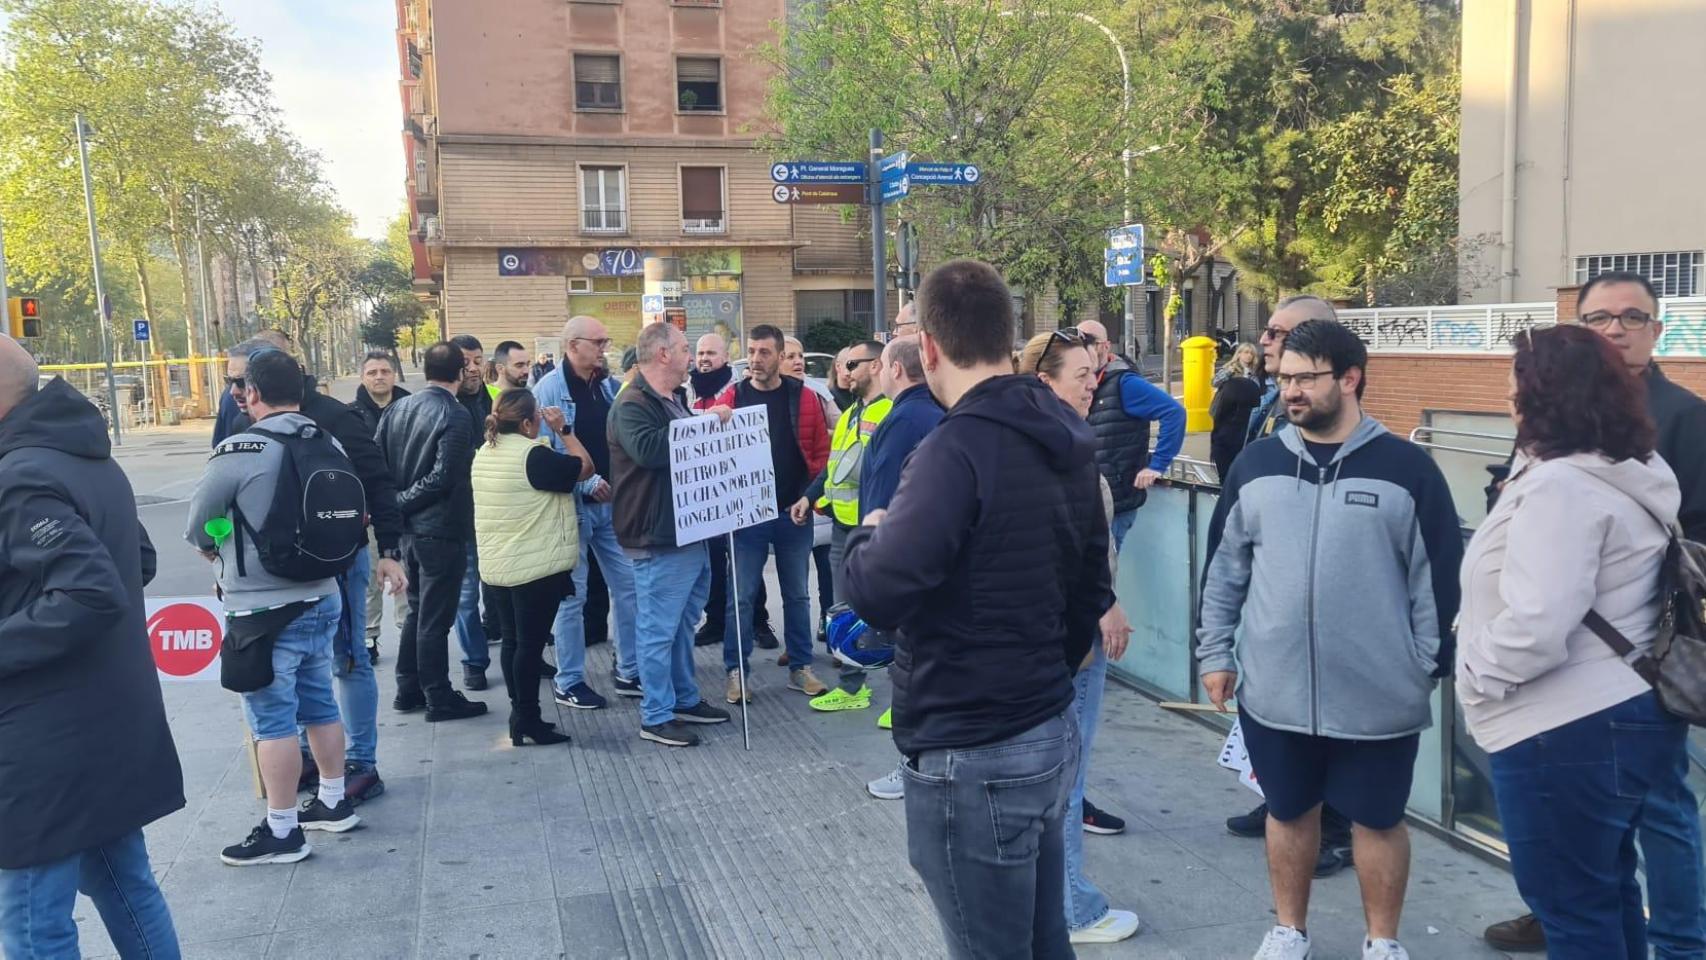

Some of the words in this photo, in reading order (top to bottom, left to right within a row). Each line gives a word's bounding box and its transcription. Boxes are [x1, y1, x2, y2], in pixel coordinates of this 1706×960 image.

[606, 248, 635, 275] 70
[138, 322, 146, 331] P
[673, 424, 697, 441] LOS
[701, 411, 765, 435] VIGILANTES
[675, 446, 691, 463] DE
[694, 433, 757, 459] SECURITAS
[674, 463, 717, 486] METRO
[719, 457, 737, 476] BCN
[729, 475, 748, 492] POR
[750, 468, 774, 486] PLUS
[678, 498, 744, 530] CONGELADO
[760, 485, 773, 500] DE
[736, 513, 744, 527] 5
[748, 504, 775, 524] AÑOS
[158, 629, 213, 651] TMB
